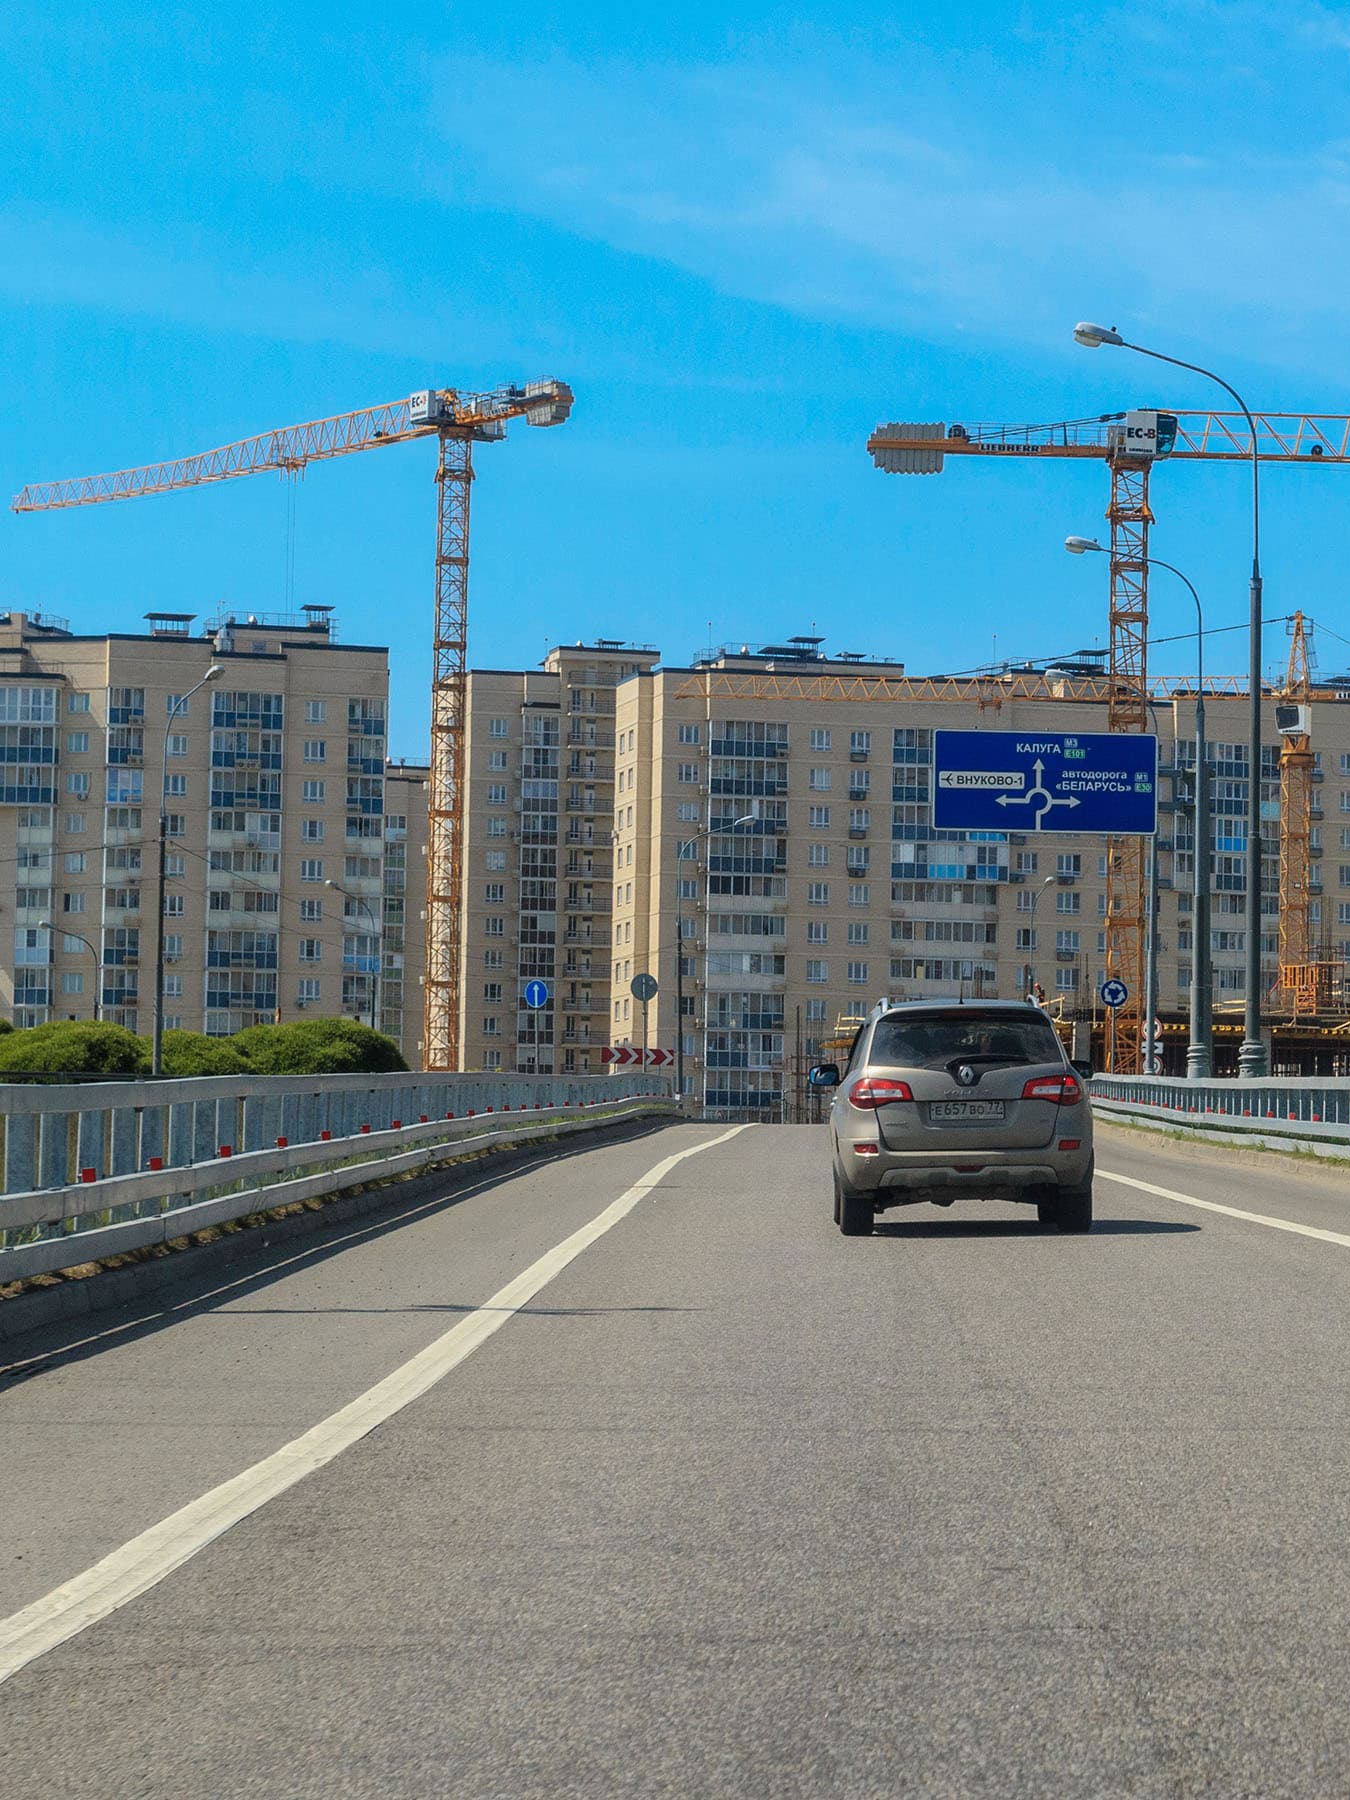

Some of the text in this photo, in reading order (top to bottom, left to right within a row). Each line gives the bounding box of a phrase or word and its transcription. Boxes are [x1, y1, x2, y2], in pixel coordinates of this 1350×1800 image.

[1127, 427, 1156, 439] EC-B
[1016, 743, 1061, 754] КАЛУГА
[956, 775, 1023, 786] ВНУКОВО-1
[1061, 770, 1128, 780] автодорога
[1055, 781, 1132, 792] «БЕЛАРУСЬ»
